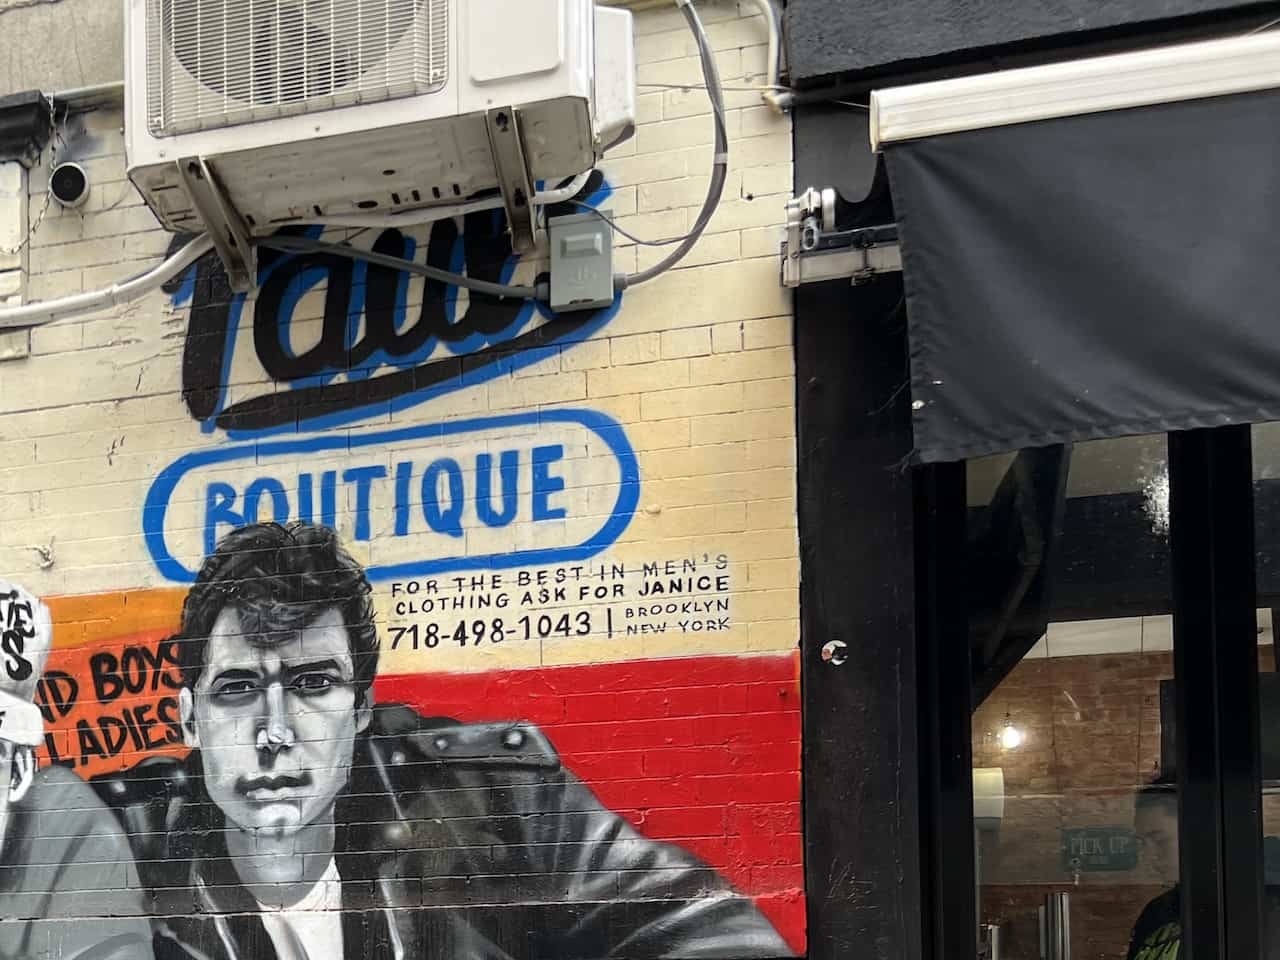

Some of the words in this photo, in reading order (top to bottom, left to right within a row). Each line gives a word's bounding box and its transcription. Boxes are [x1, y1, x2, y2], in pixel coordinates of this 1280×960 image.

[204, 444, 567, 558] BOUTIQUE
[392, 580, 438, 597] FOR
[454, 574, 502, 592] THE
[518, 567, 583, 586] BEST
[600, 561, 624, 580] IN
[643, 553, 728, 577] MEN'S
[396, 593, 509, 615] CLOTHING
[521, 587, 566, 606] ASK
[579, 584, 625, 601] FOR
[638, 575, 730, 597] JANICE
[625, 599, 730, 619] BROOKLYN
[627, 621, 666, 635] NEW
[679, 617, 731, 633] YORK
[387, 611, 592, 651] 718-498-1043
[90, 636, 186, 704] BOYS
[44, 697, 184, 768] LADIES
